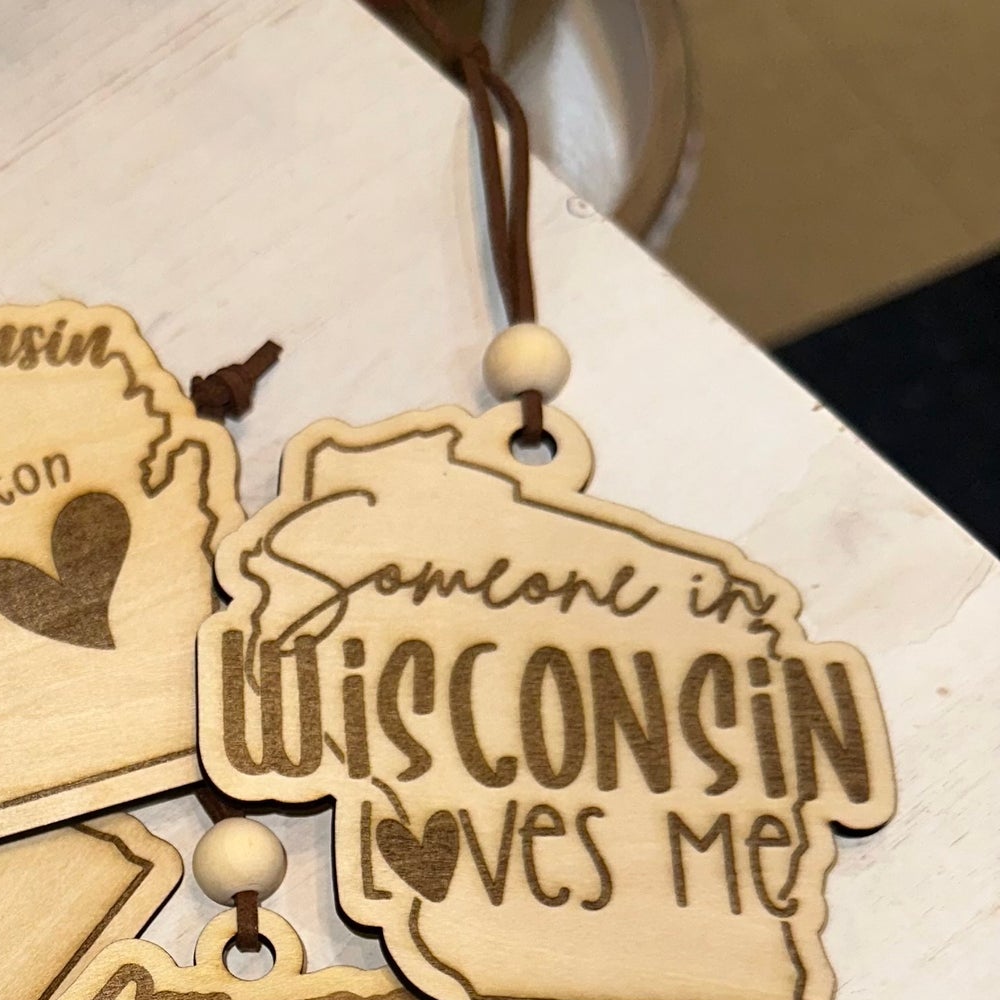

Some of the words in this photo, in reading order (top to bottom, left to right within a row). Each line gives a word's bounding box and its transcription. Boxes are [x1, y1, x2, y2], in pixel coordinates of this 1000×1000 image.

[264, 489, 660, 656] Someone
[690, 574, 777, 623] in
[667, 811, 799, 919] Me
